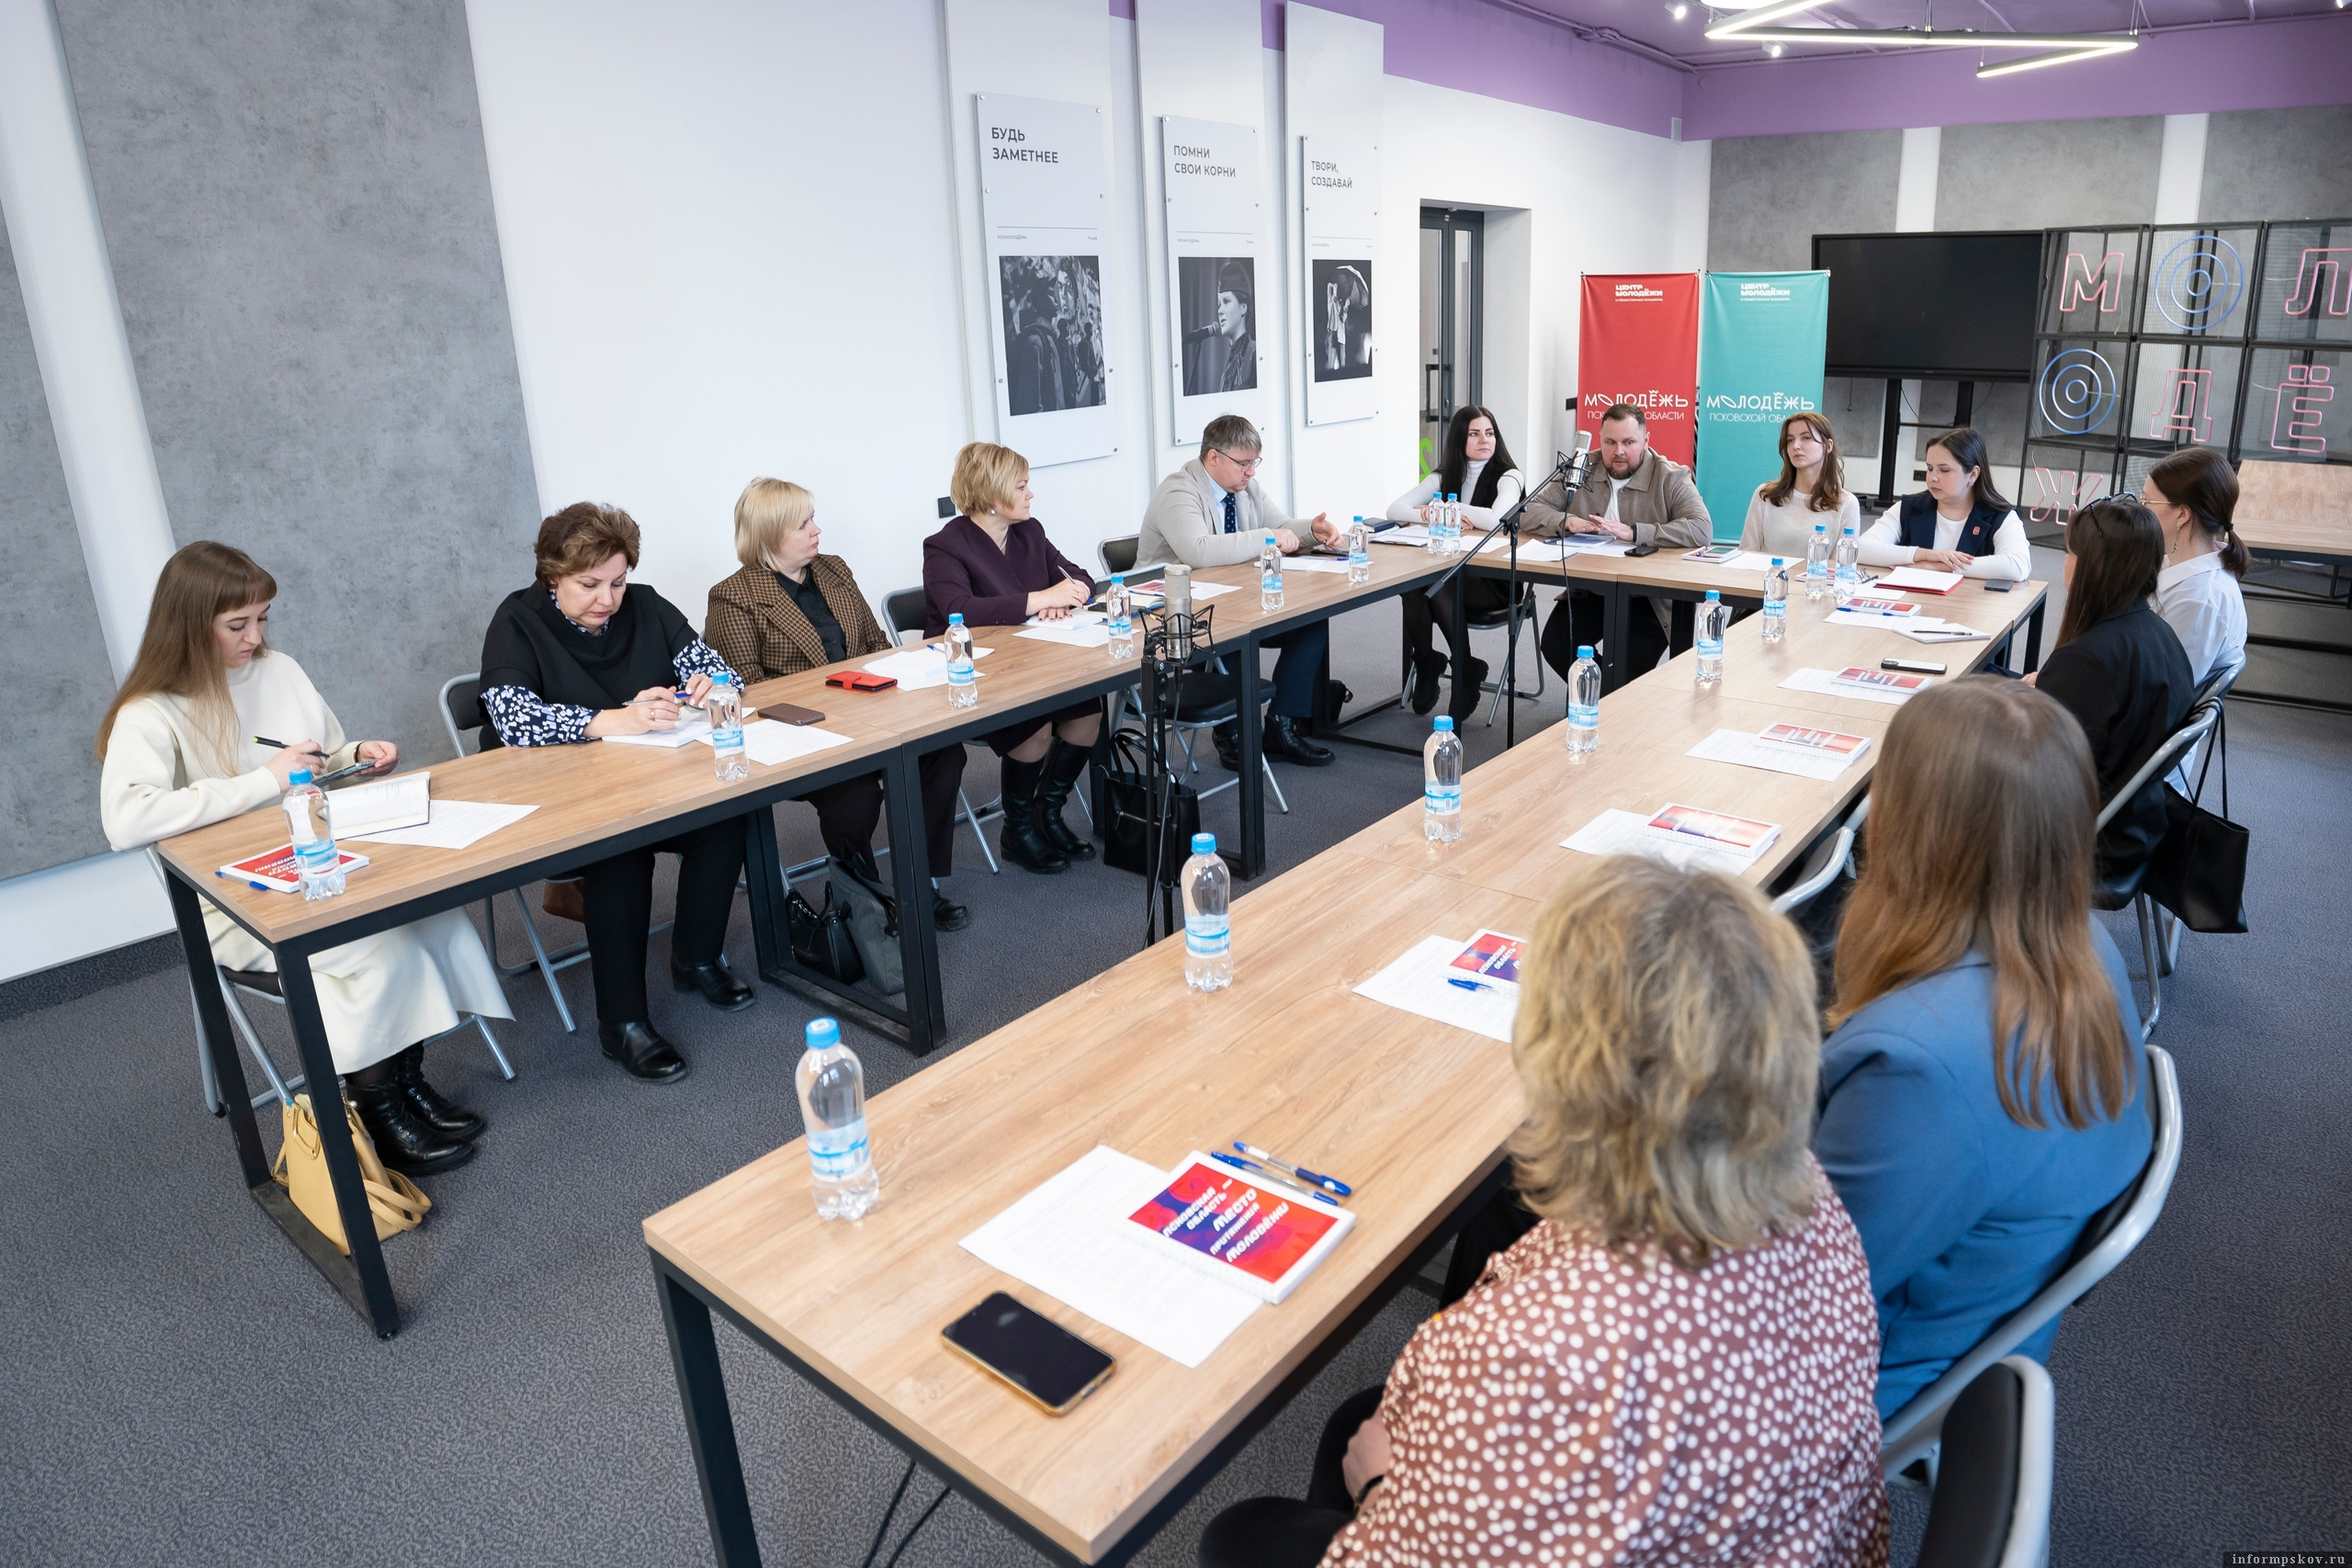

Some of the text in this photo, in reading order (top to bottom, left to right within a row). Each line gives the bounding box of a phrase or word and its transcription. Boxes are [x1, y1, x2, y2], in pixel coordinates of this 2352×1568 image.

[991, 127, 1025, 143] БУДЬ
[992, 147, 1058, 164] ЗАМЕТНЕЕ
[1173, 145, 1210, 159] ПОМНИ
[1174, 163, 1236, 177] СВОИ КОРНИ
[1311, 161, 1339, 174] ТВОРИ,
[1311, 176, 1352, 188] СОЗДАВАЙ
[1615, 288, 1663, 297] МОЛОДЁЖИ
[1740, 287, 1791, 296] МОЛОДЁЖИ
[1706, 391, 1815, 412] МОЛОДЁЖЬ
[1645, 412, 1685, 421] ОБЛАСТИ
[1709, 412, 1766, 423] ПСКОВСКОЙ
[1162, 1186, 1216, 1237] ПСКОВСКАЯ
[1186, 1192, 1227, 1231] ОБЛАСТЬ
[1212, 1188, 1258, 1232] МЕСТО
[1209, 1201, 1261, 1256] ПРИТЯЖЕНИЯ
[1225, 1201, 1290, 1263] МОЛОДЁЖИ
